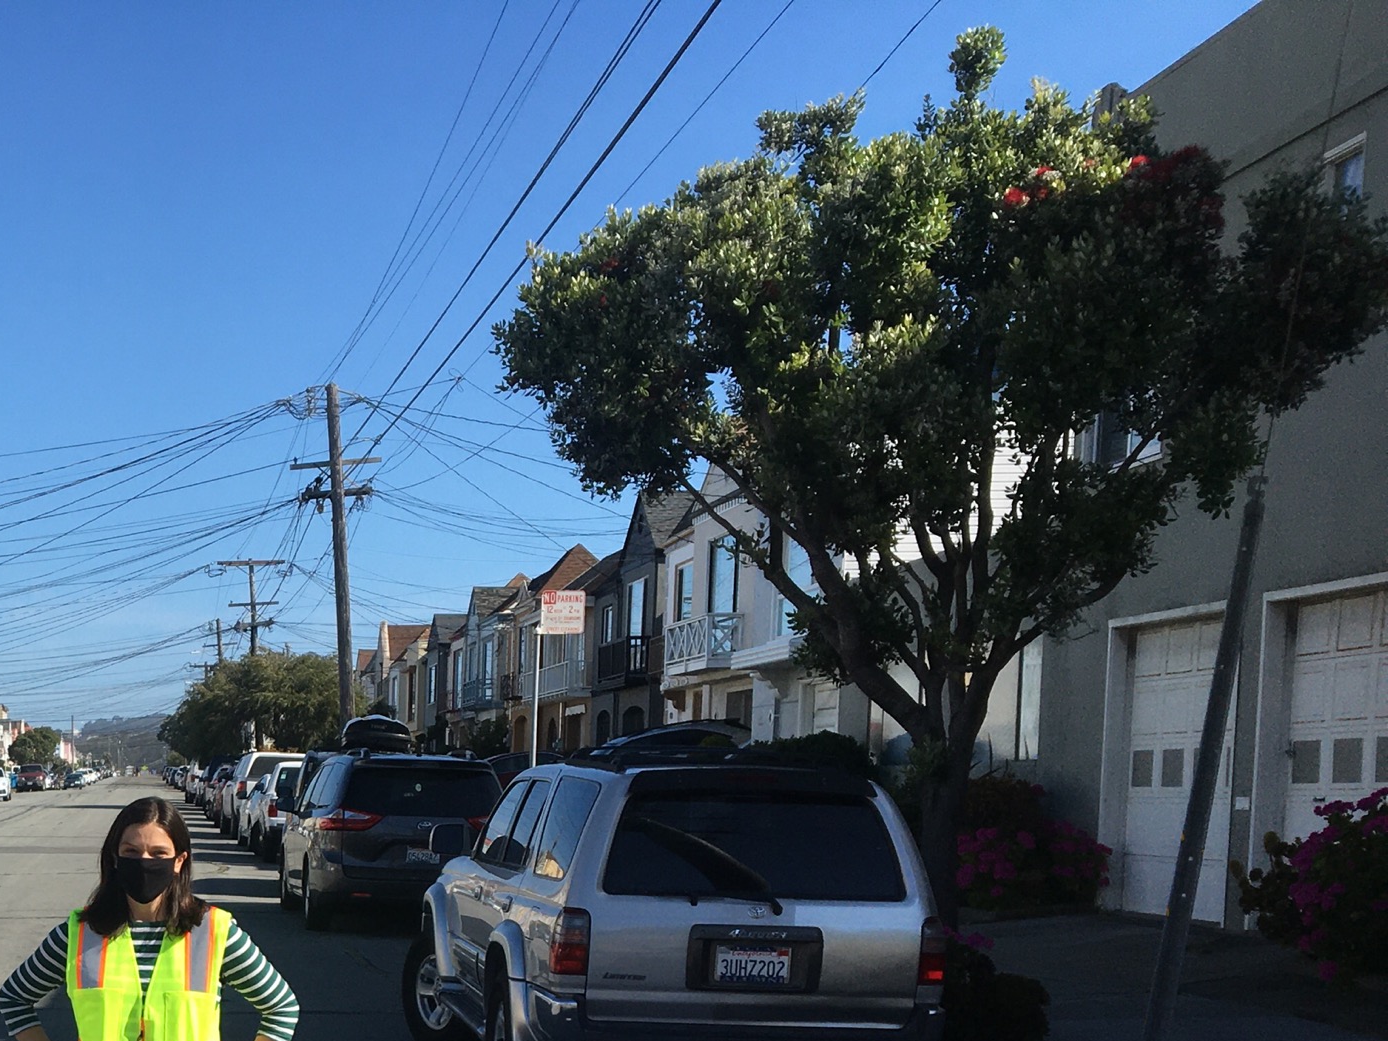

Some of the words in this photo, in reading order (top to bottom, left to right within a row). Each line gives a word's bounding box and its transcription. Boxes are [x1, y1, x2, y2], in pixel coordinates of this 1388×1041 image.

[545, 592, 556, 603] NO
[558, 595, 583, 603] PARKING
[720, 959, 785, 977] 3UHZ202
